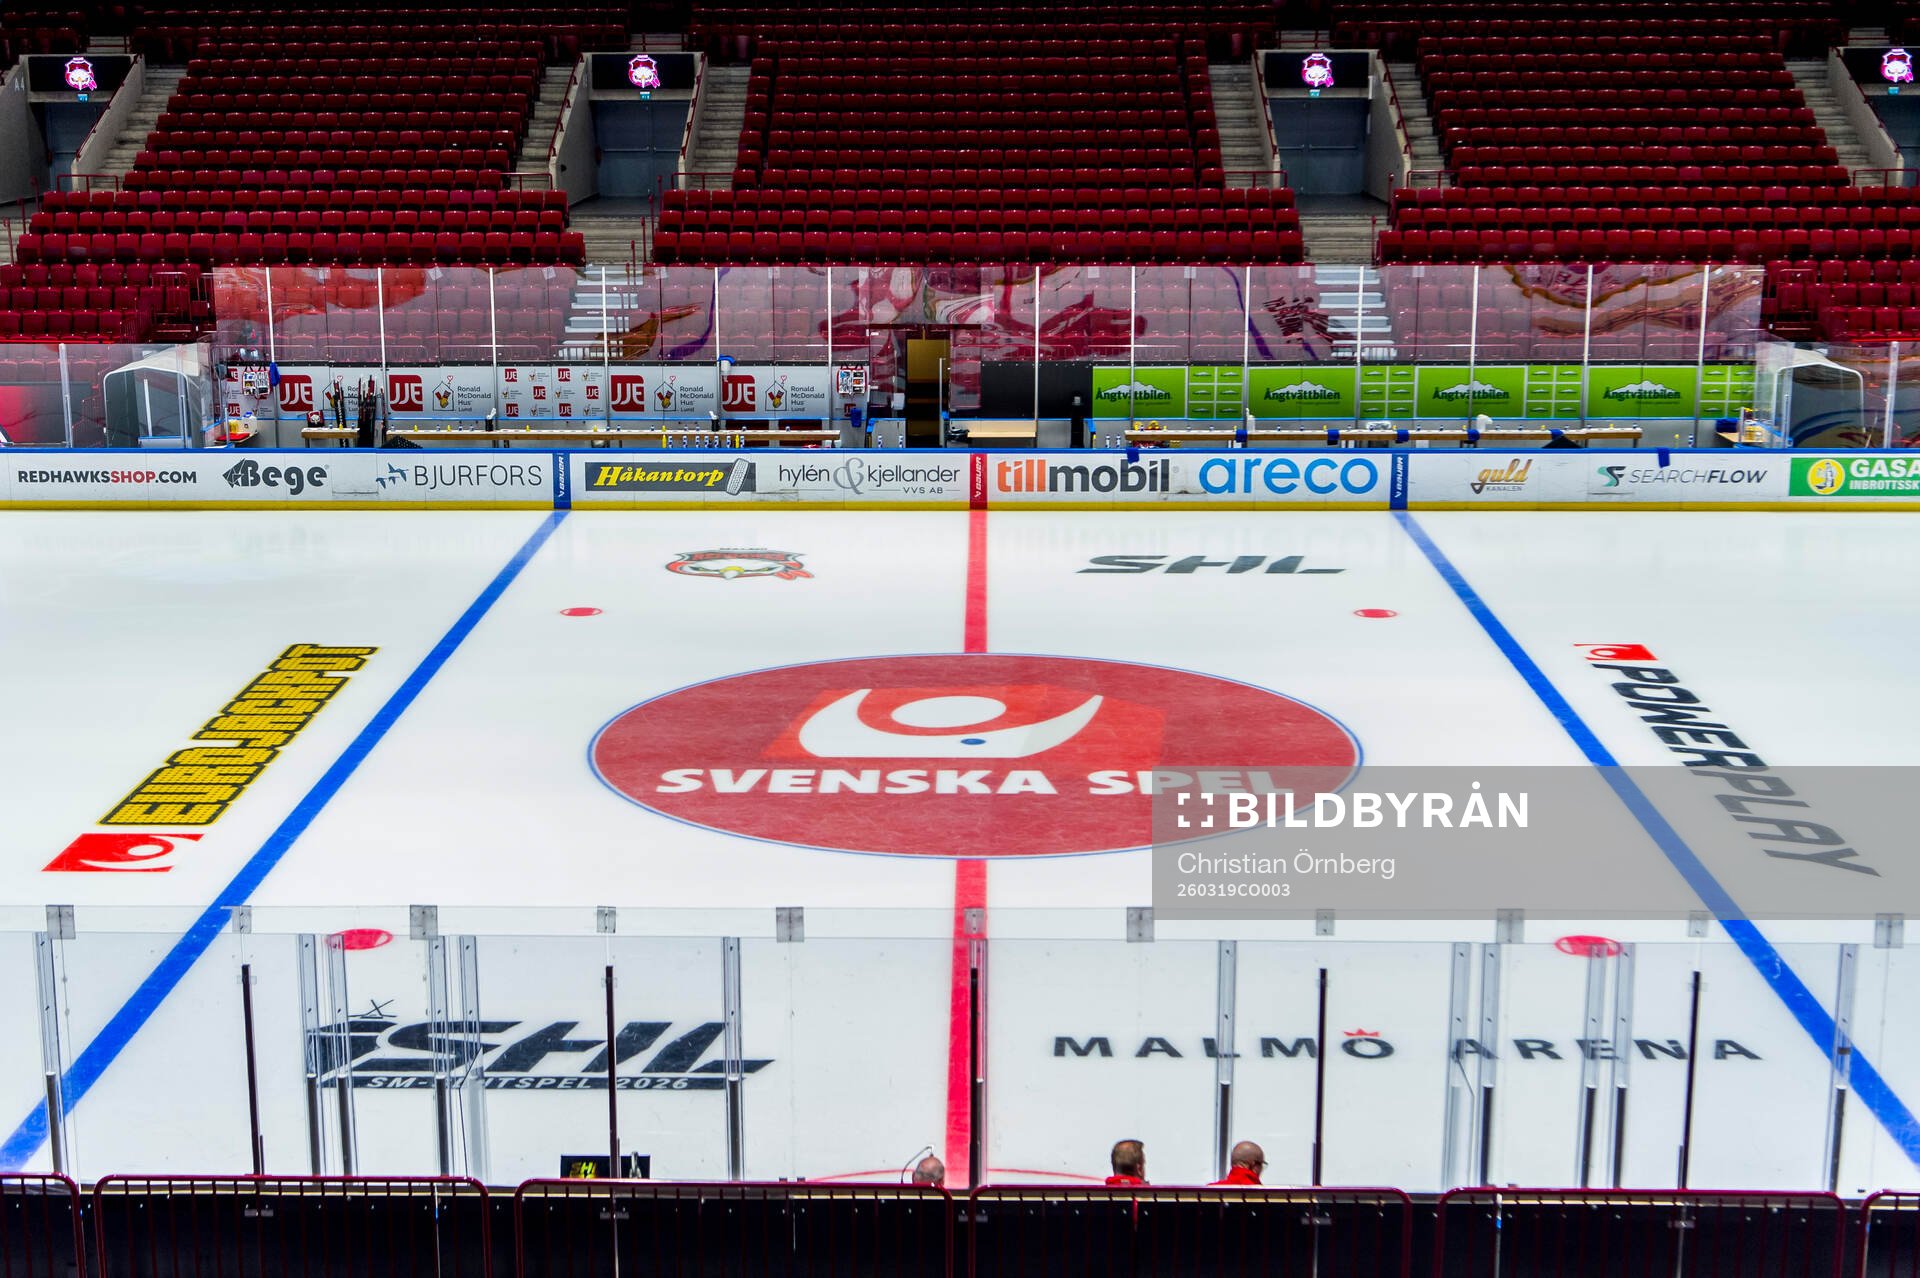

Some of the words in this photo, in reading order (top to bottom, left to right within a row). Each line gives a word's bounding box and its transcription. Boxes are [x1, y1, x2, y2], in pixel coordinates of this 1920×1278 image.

[505, 370, 518, 380] JJE
[558, 370, 571, 380] JJE
[279, 383, 313, 405] JJE
[389, 383, 423, 405] JJE
[534, 388, 547, 398] JJE
[586, 388, 599, 398] JJE
[610, 383, 645, 405] JJE
[721, 383, 755, 405] JJE
[1263, 387, 1341, 402] Ångtvättbilen
[1602, 387, 1682, 402] Ångtvättbilen
[507, 405, 519, 415] JJE
[559, 405, 572, 415] JJE
[17, 470, 197, 483] REDHAWKSSHOP.COM
[240, 459, 328, 495] Bege
[414, 465, 542, 489] BJURFORS
[593, 465, 724, 487] Håkantorp
[779, 465, 830, 487] hylén
[833, 457, 864, 495] &
[867, 465, 960, 487] kjellander
[997, 459, 1170, 492] tillmobil
[1199, 457, 1378, 494] areco
[1396, 456, 1404, 488] BAUER
[1471, 458, 1533, 495] guld
[1629, 469, 1768, 483] SEARCHFLOW
[1849, 480, 1920, 490] INBROTTSSK
[1076, 555, 1347, 575] SHL
[96, 644, 381, 826] EUROJACKPOT
[655, 767, 1060, 796] SVENSKA
[1086, 768, 1293, 797] SPEL
[1590, 664, 1882, 878] POWERPLAY
[350, 1020, 776, 1074] SHL
[1449, 1038, 1764, 1061] ARENA
[367, 1077, 592, 1090] SM-LTSPEL
[617, 1077, 689, 1090] 2026
